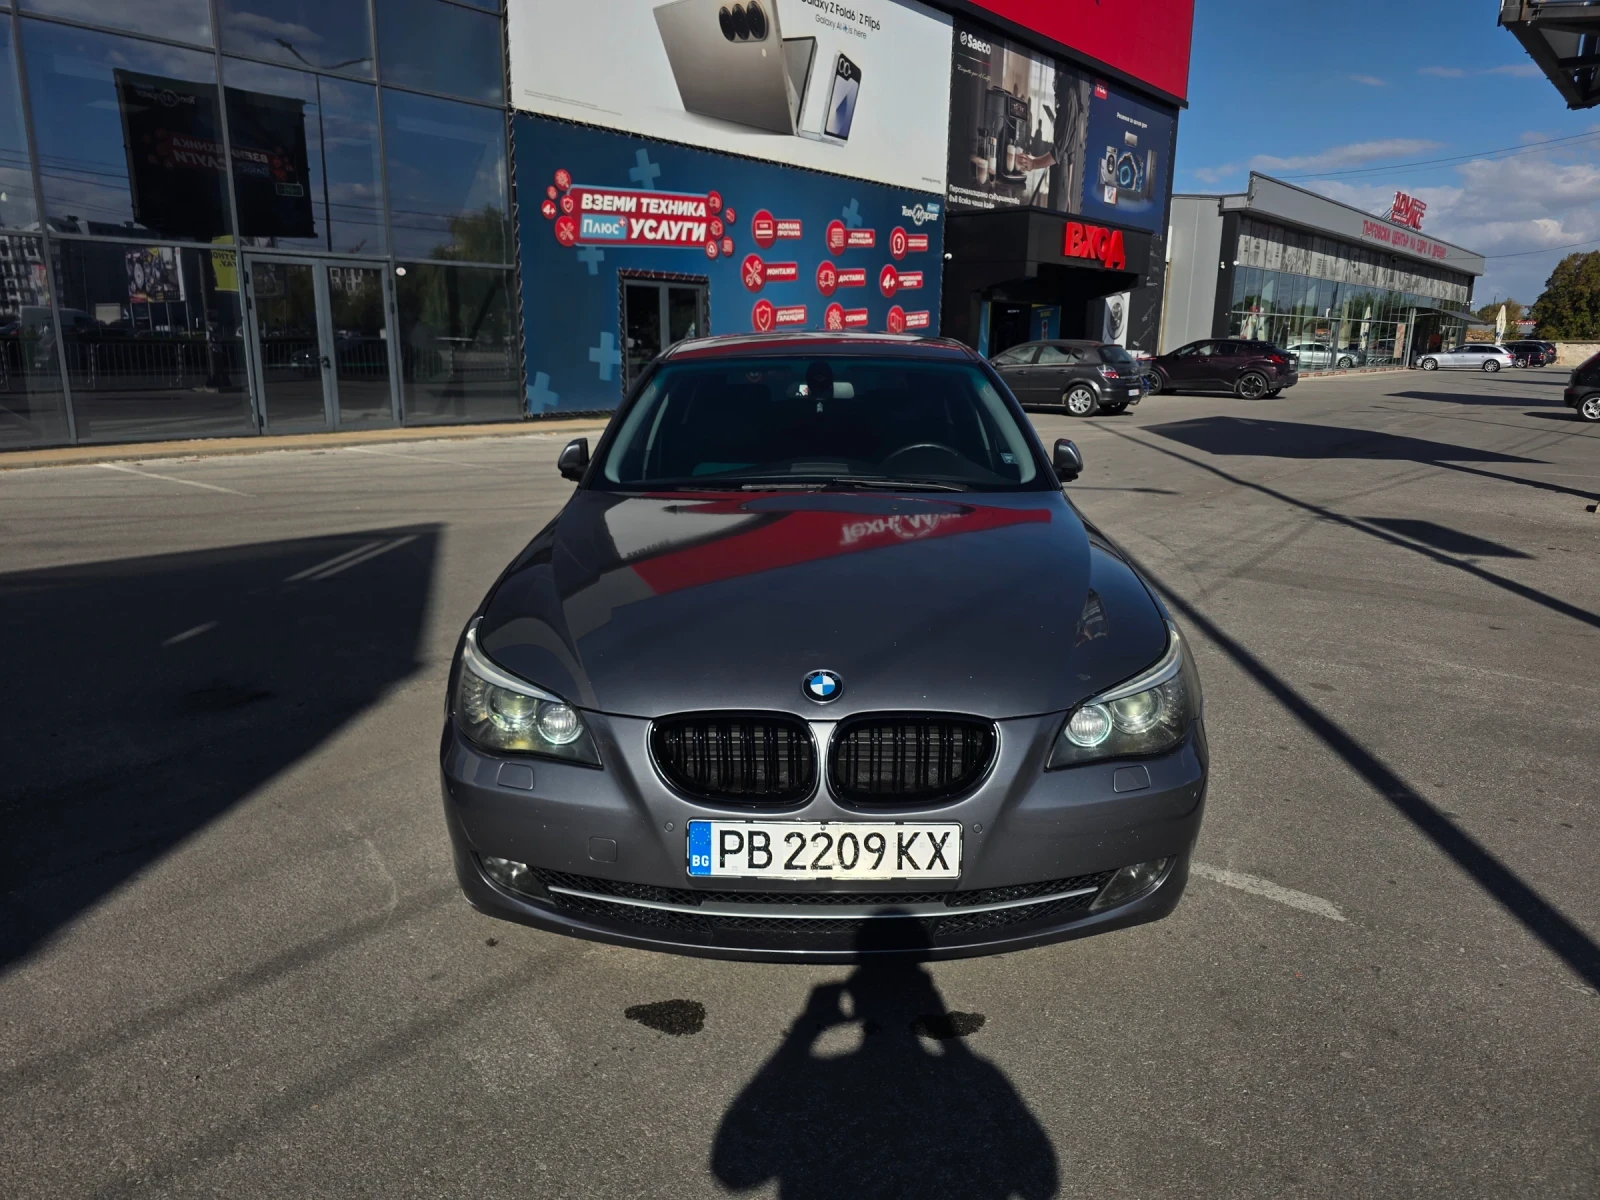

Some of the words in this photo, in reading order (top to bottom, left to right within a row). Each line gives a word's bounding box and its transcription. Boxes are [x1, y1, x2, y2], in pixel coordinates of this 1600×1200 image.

[802, 0, 829, 13] alaxy
[830, 2, 834, 13] Z
[836, 4, 856, 21] Fold6
[860, 14, 864, 24] Z
[864, 16, 880, 32] Flip6
[815, 14, 836, 30] Galaxy
[854, 28, 867, 40] here
[967, 33, 992, 55] Saeco
[581, 193, 637, 212] ВЗЕМИ
[640, 197, 706, 217] ТЕХНИКА
[630, 218, 707, 242] УСЛУГИ
[1065, 222, 1126, 270] ВХОД
[766, 267, 796, 276] МОНТАЖИ
[838, 273, 865, 282] ДОСТАВКА
[692, 855, 710, 866] BG
[719, 830, 773, 869] PB
[784, 831, 886, 870] 2209
[896, 831, 952, 870] KX
